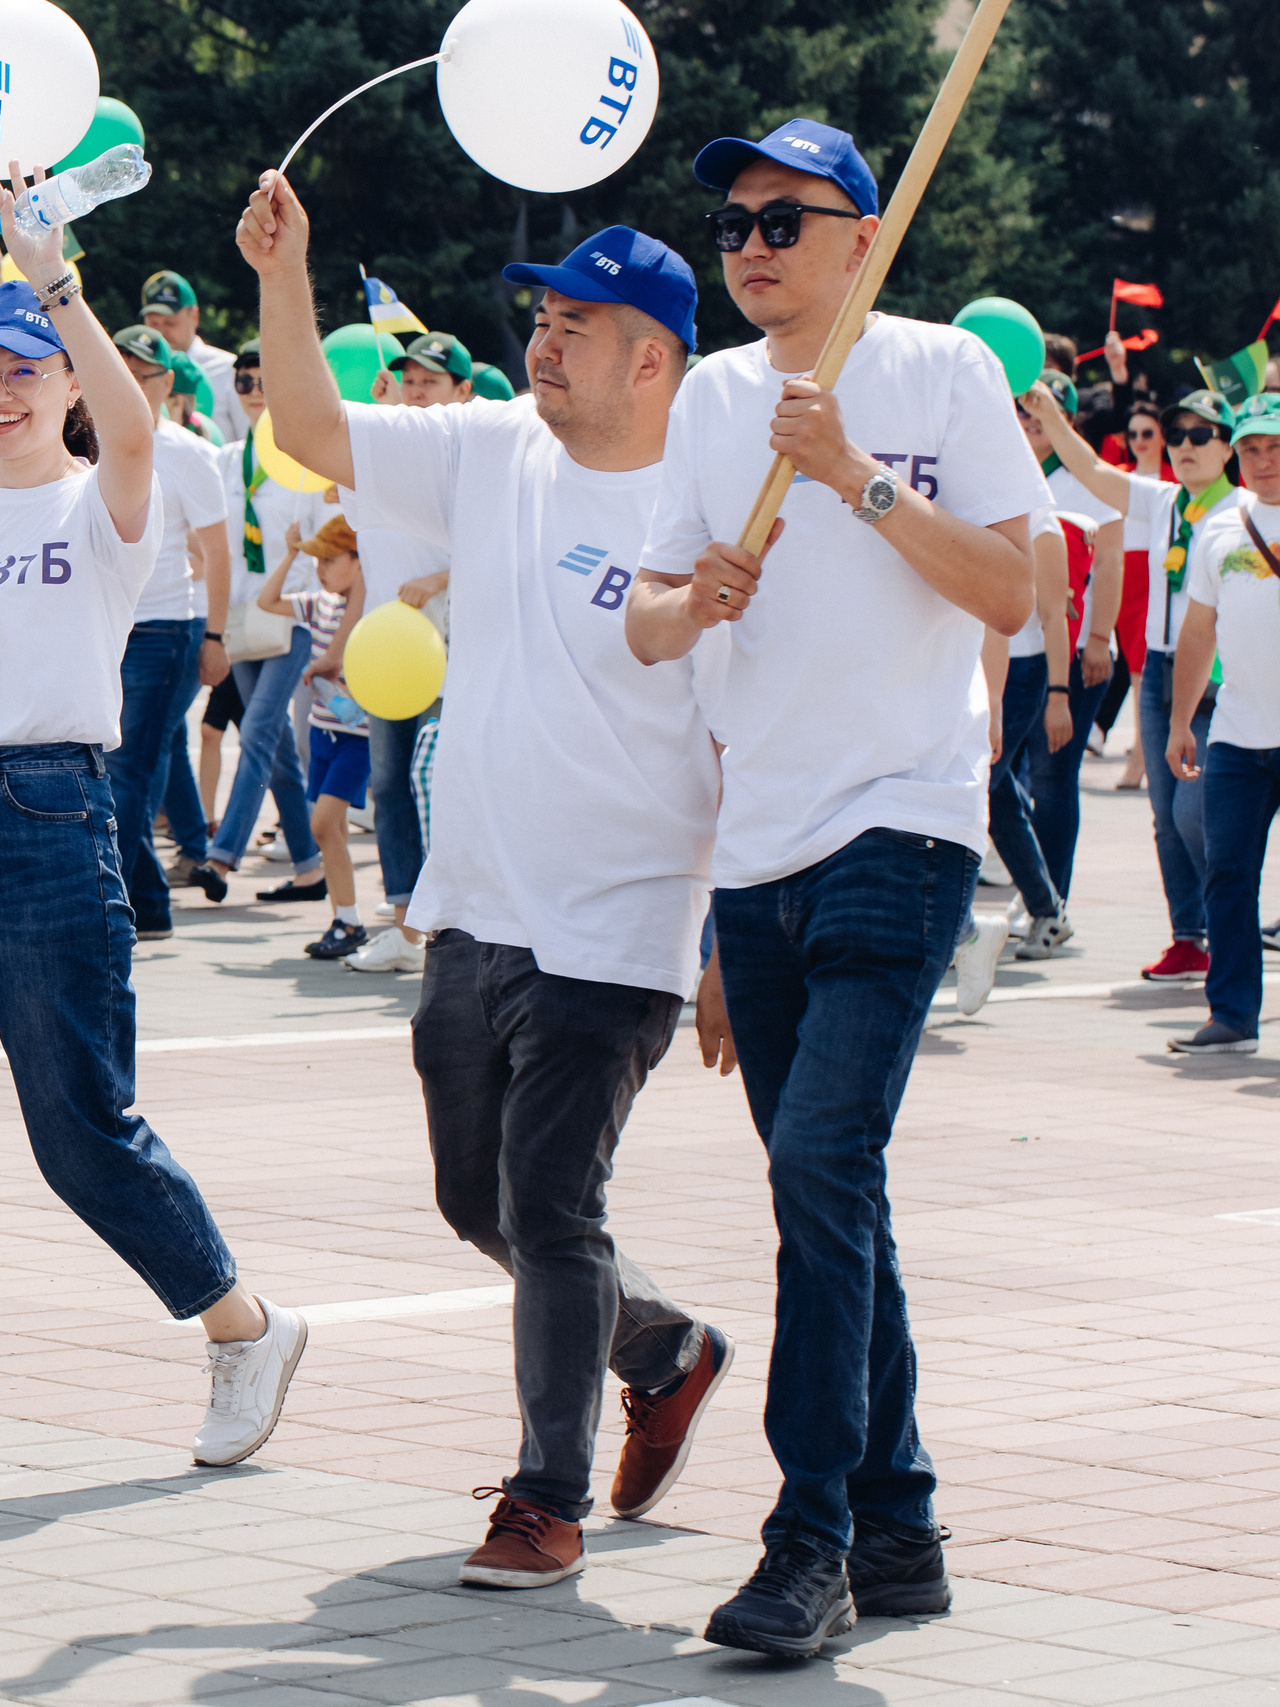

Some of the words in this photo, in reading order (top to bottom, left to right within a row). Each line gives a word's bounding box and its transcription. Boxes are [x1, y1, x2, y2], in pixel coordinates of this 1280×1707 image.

[579, 56, 637, 150] ВТБ
[790, 138, 821, 154] ВТБ
[595, 256, 622, 276] ВТБ
[25, 311, 49, 328] ВТБ
[841, 453, 938, 503] ТБ
